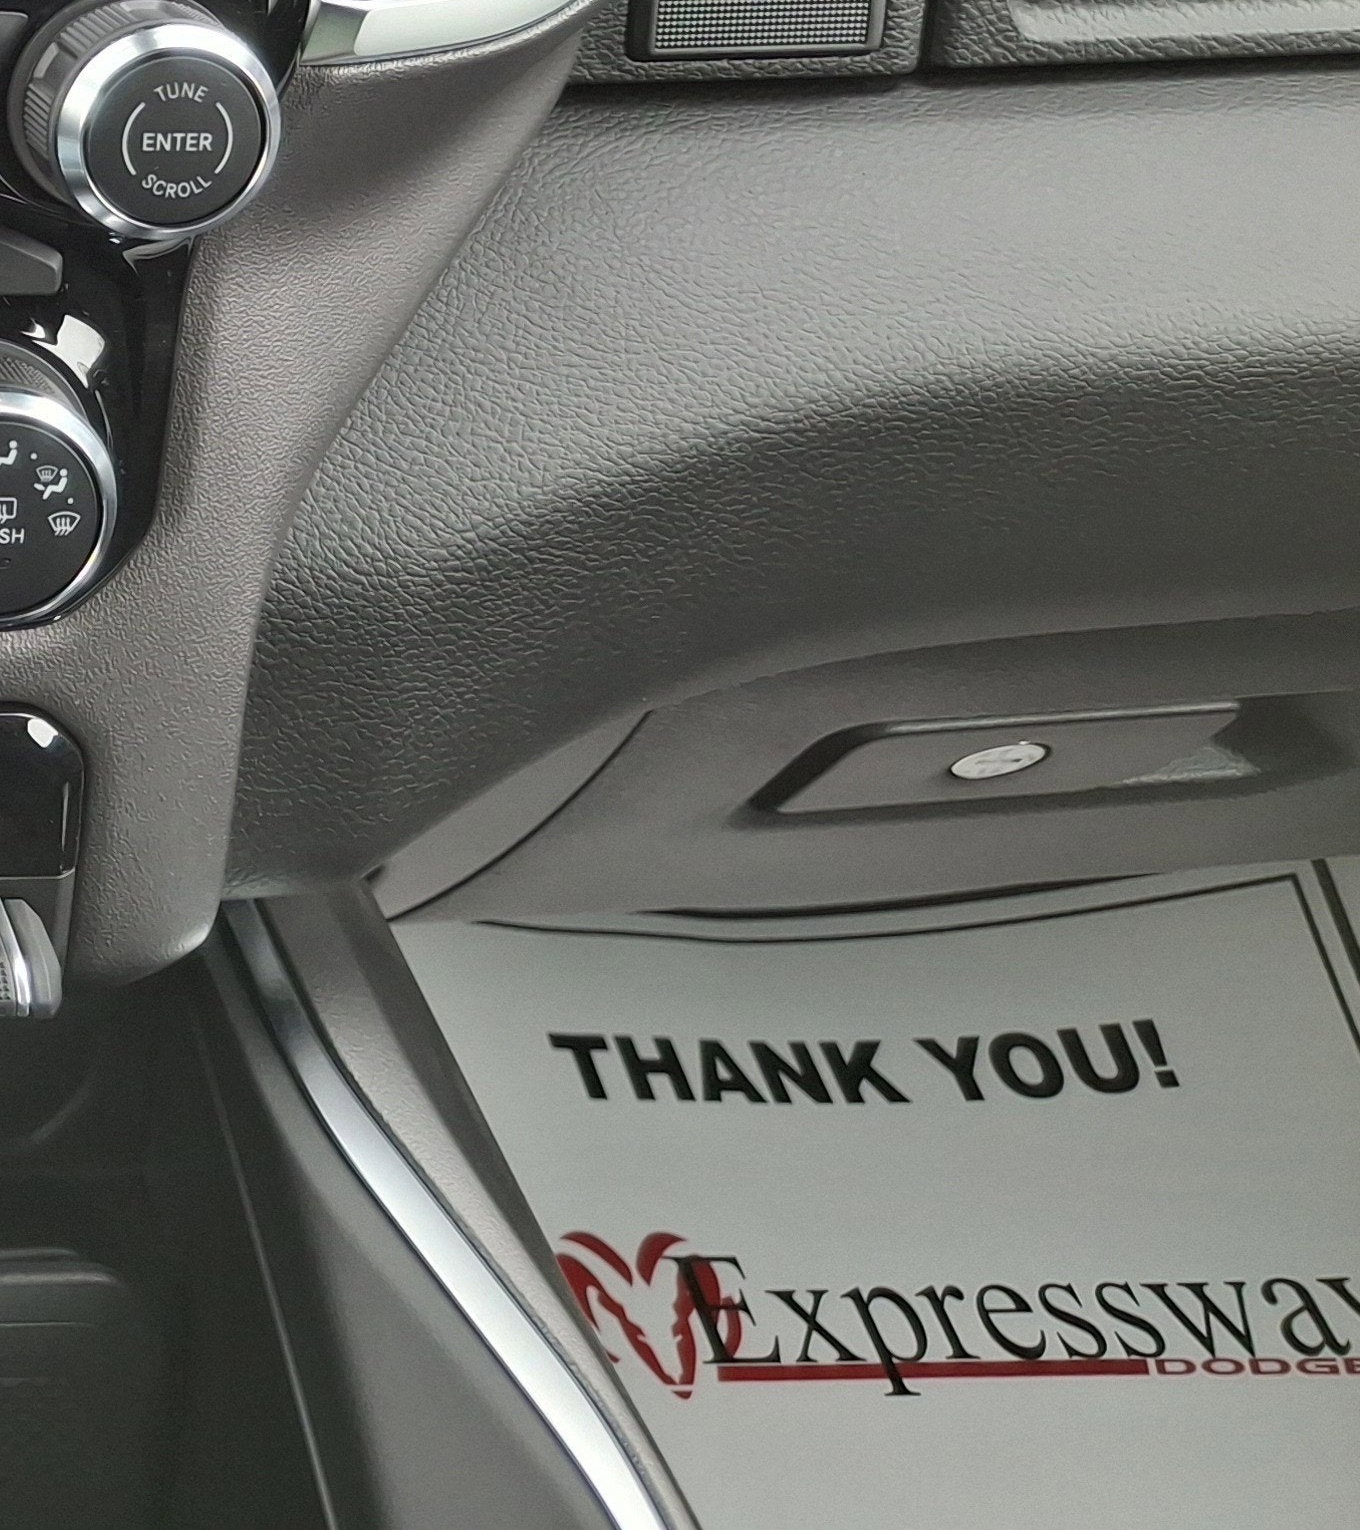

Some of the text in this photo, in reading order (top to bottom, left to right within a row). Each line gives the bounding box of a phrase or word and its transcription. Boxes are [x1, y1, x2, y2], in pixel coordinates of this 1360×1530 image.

[154, 82, 209, 103] TUNE
[142, 133, 213, 152] ENTER
[141, 174, 212, 199] SCROLL
[549, 1018, 1180, 1104] THANK YOU!
